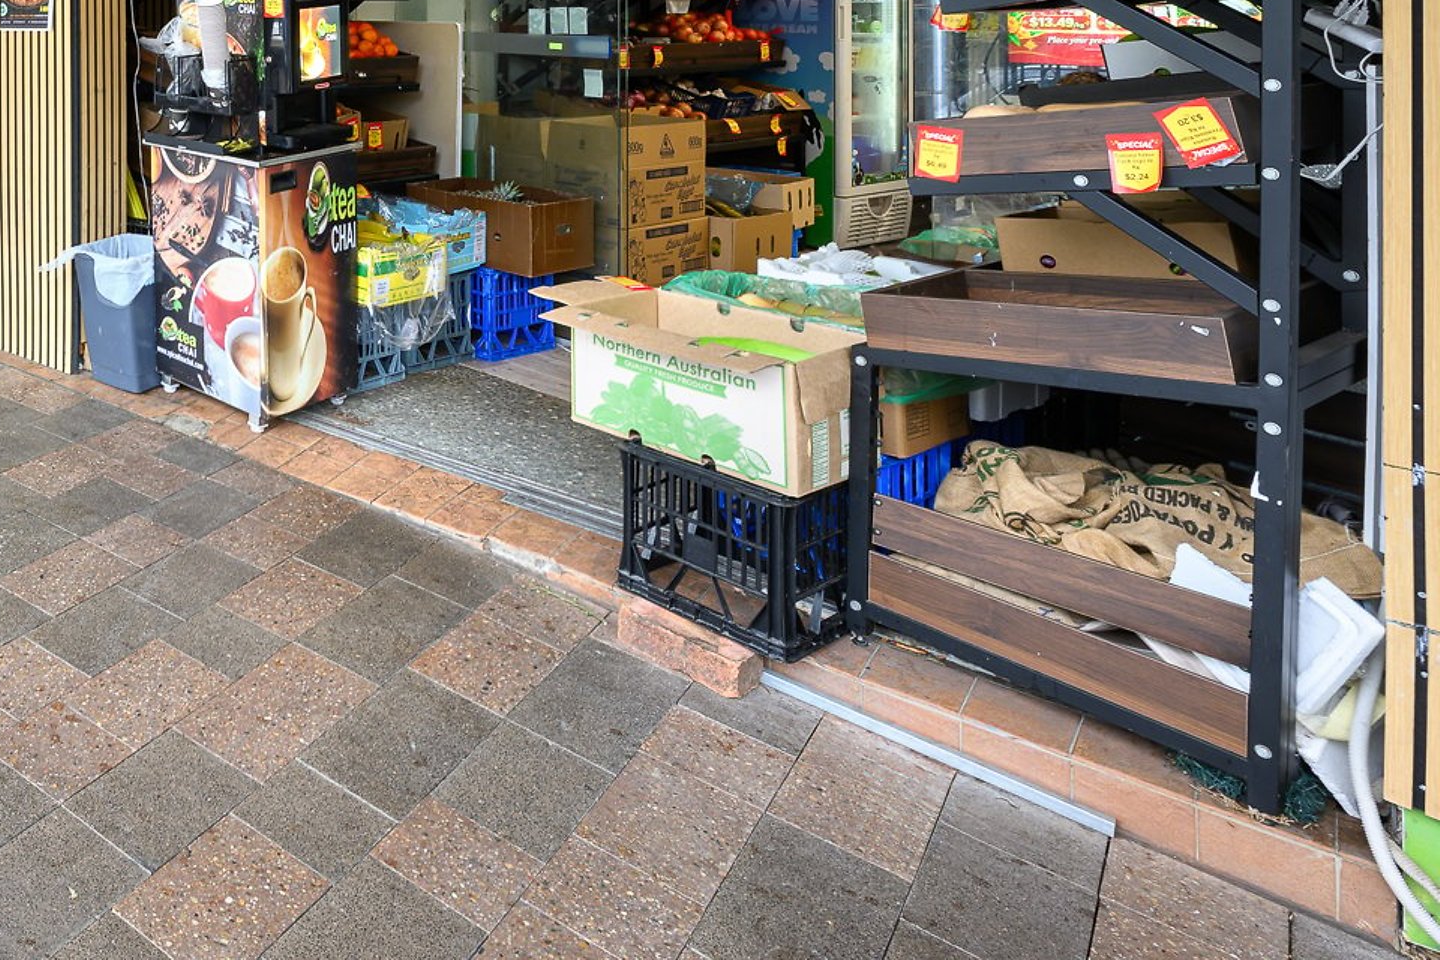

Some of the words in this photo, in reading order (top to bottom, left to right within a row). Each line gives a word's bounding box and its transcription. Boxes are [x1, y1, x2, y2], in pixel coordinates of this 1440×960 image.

[1047, 36, 1067, 45] Place
[1067, 37, 1088, 46] your
[1116, 139, 1154, 149] SPECIAL
[1191, 142, 1229, 158] SPECIAL
[330, 221, 357, 254] CHAI
[177, 342, 197, 359] CHAI
[593, 333, 661, 365] Northern
[666, 355, 757, 391] Australian
[1143, 485, 1213, 515] PACKED
[1110, 499, 1216, 546] POTATOES
